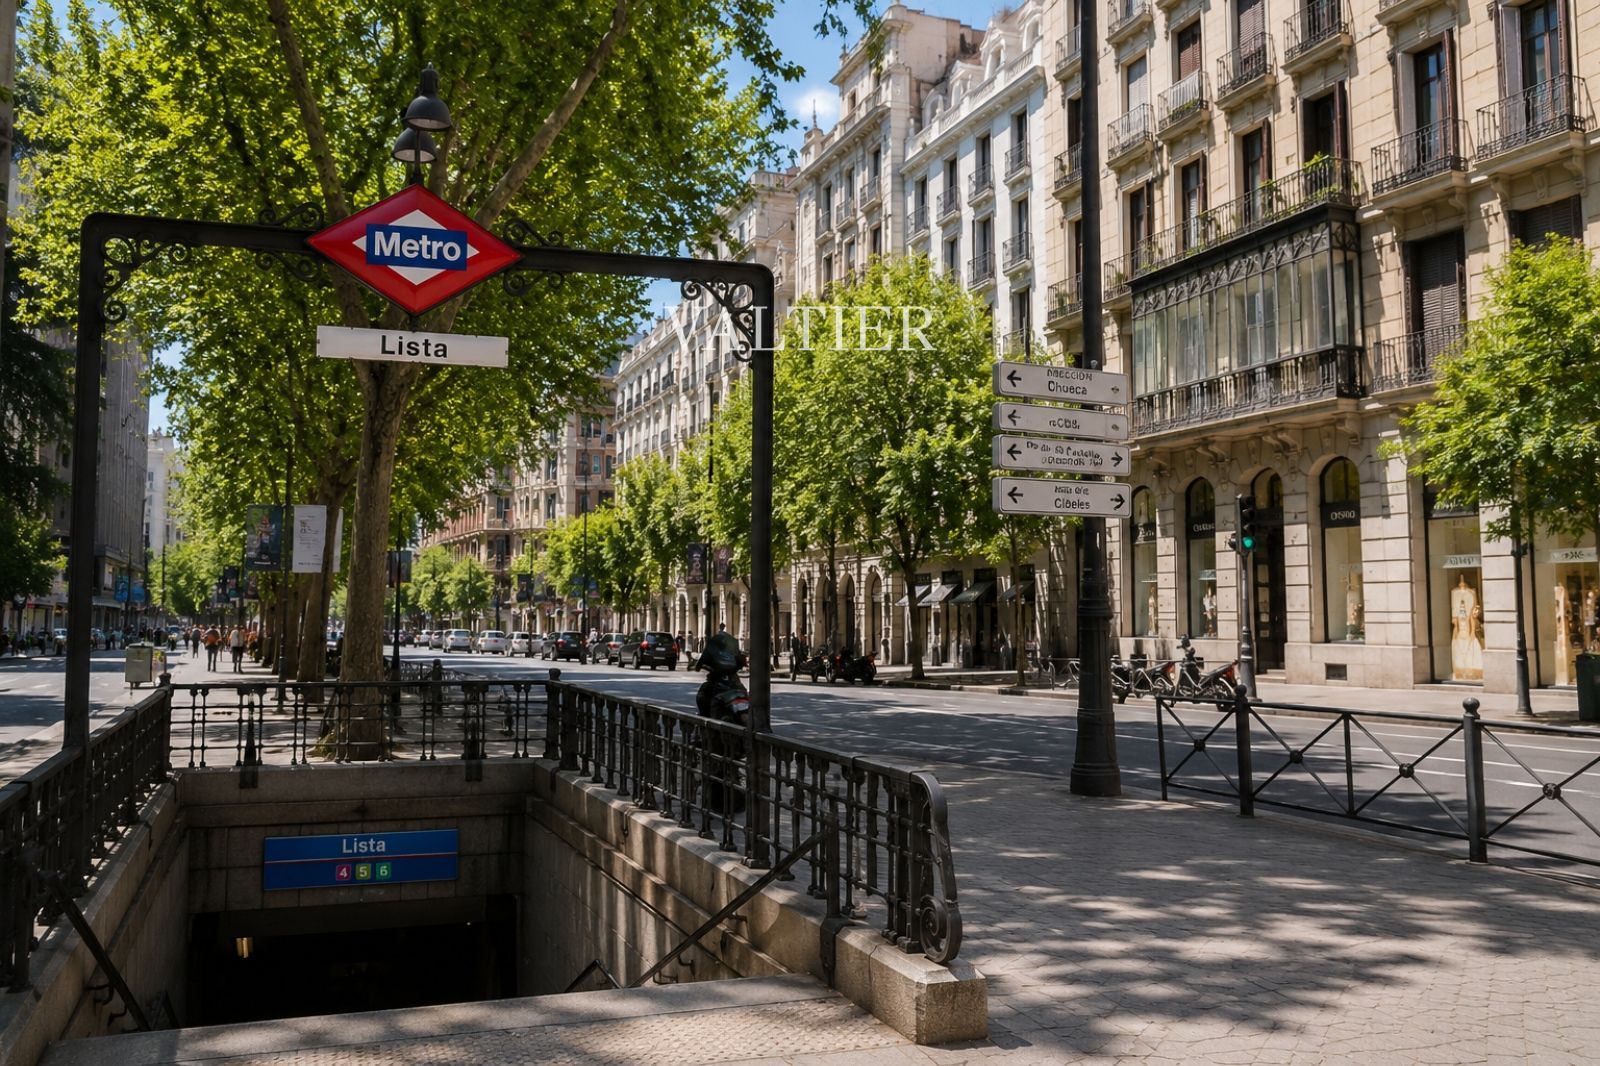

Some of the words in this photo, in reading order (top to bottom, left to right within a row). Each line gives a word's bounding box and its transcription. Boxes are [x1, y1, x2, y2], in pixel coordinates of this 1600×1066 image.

[374, 231, 461, 261] Metro
[381, 334, 448, 358] Lista
[342, 838, 386, 853] Lista
[339, 867, 348, 878] 4
[359, 866, 368, 878] 5
[380, 865, 388, 876] 6
